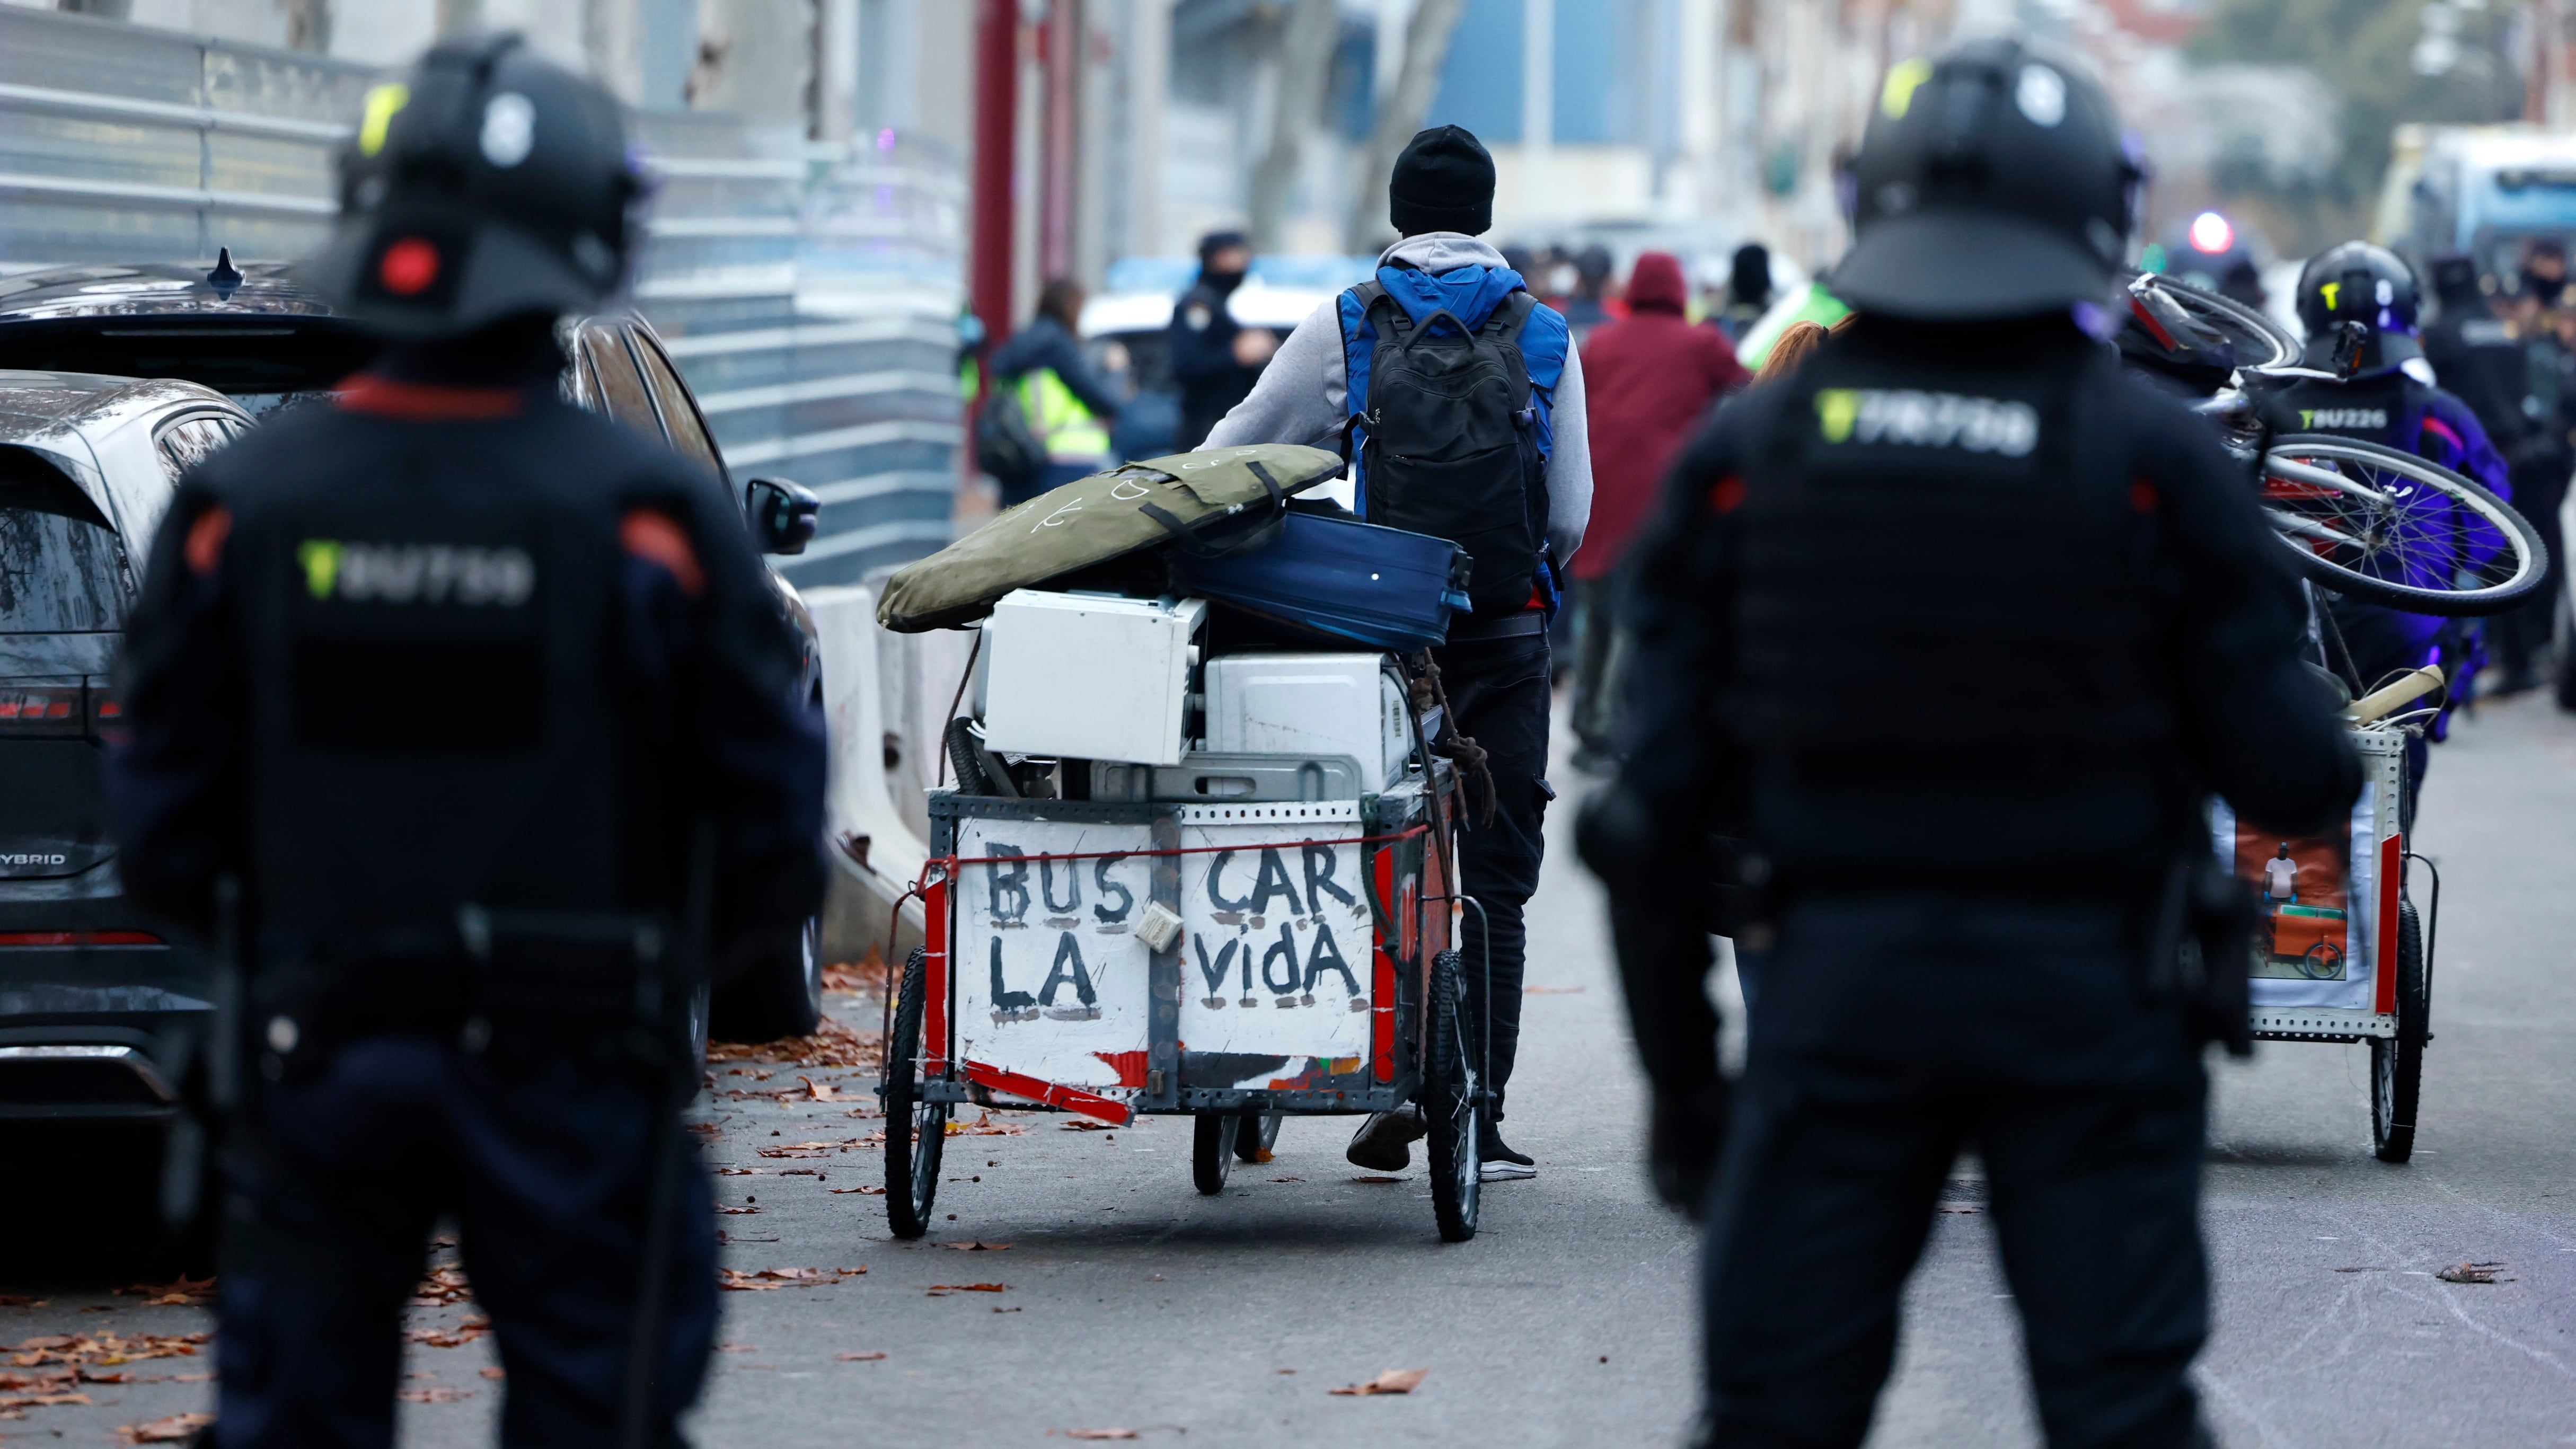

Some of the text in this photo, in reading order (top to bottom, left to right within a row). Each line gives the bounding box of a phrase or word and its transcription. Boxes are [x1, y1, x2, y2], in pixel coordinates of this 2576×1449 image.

[0, 854, 65, 865] YBRID
[985, 837, 1356, 926] BUS CAR
[990, 931, 1097, 1008] LA
